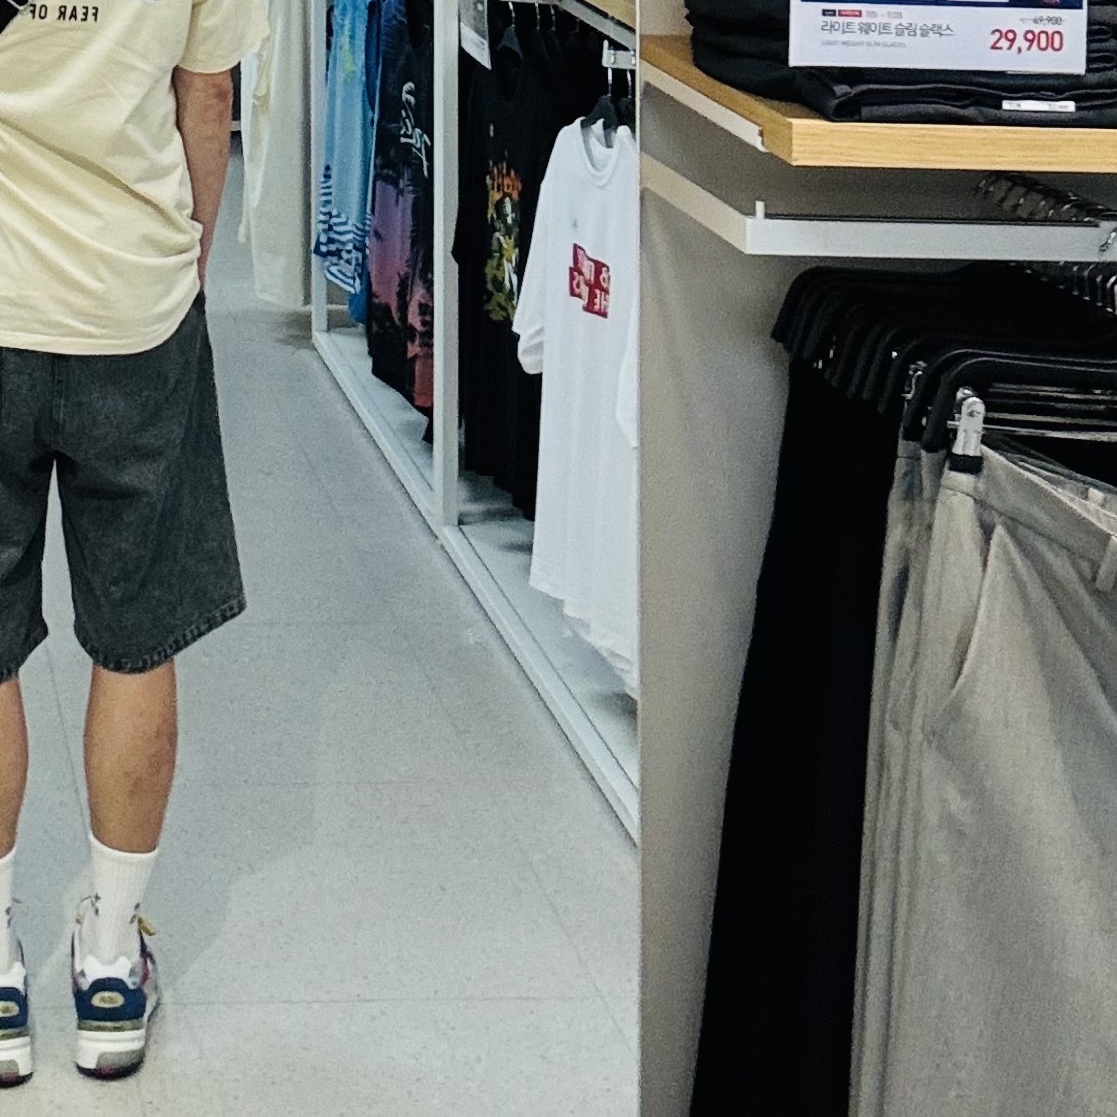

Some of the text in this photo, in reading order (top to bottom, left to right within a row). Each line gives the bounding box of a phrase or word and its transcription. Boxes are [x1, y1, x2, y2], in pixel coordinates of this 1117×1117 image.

[821, 20, 857, 35] 라이트
[894, 22, 917, 37] 슬림
[919, 23, 956, 38] 슬랙스
[990, 29, 1063, 55] 29,900
